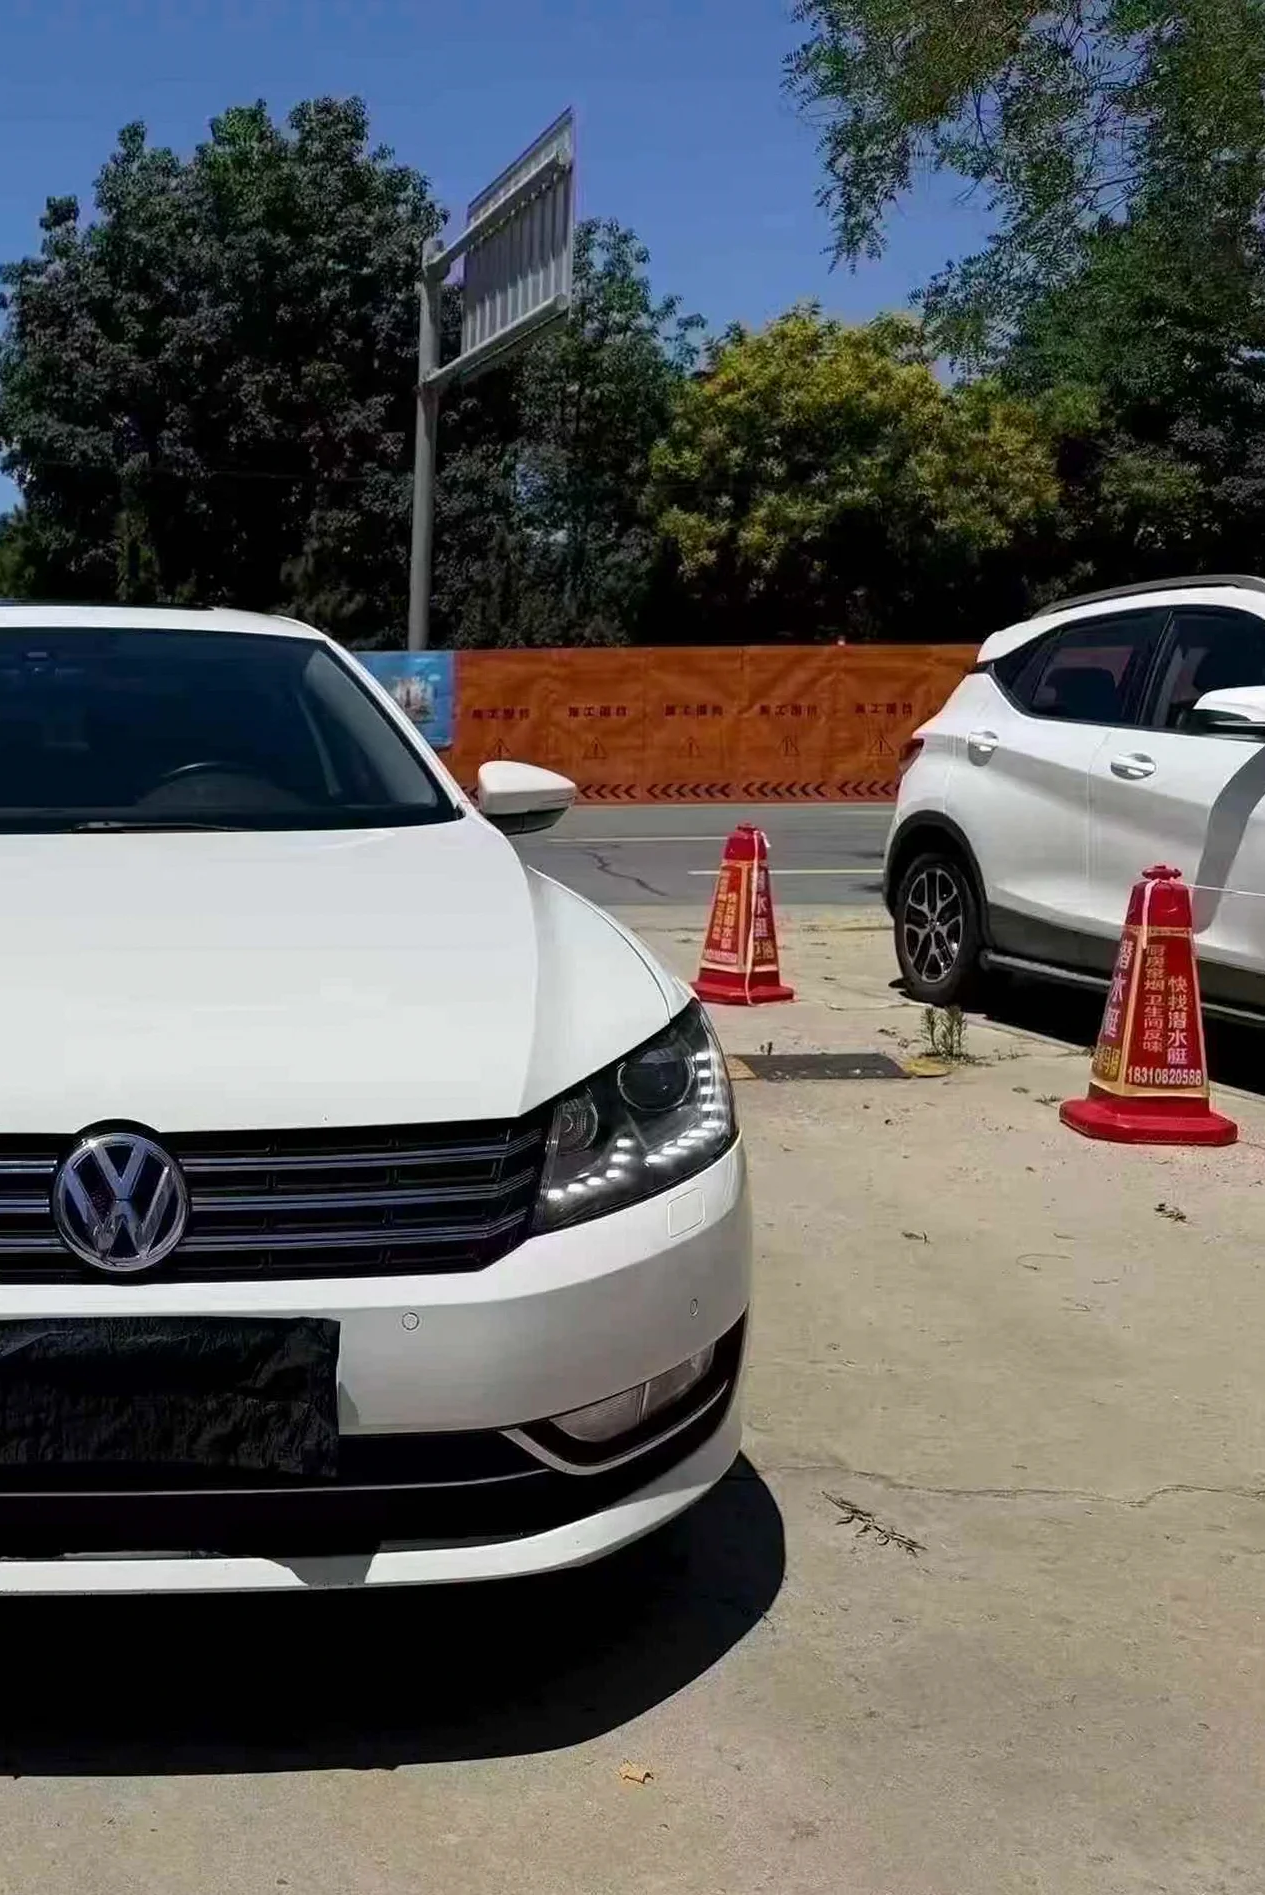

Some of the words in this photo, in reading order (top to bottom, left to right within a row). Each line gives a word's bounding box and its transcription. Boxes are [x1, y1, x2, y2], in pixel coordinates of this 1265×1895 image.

[1167, 975, 1188, 1065] 快找潜水艇
[1127, 1067, 1202, 1085] 18310820588
